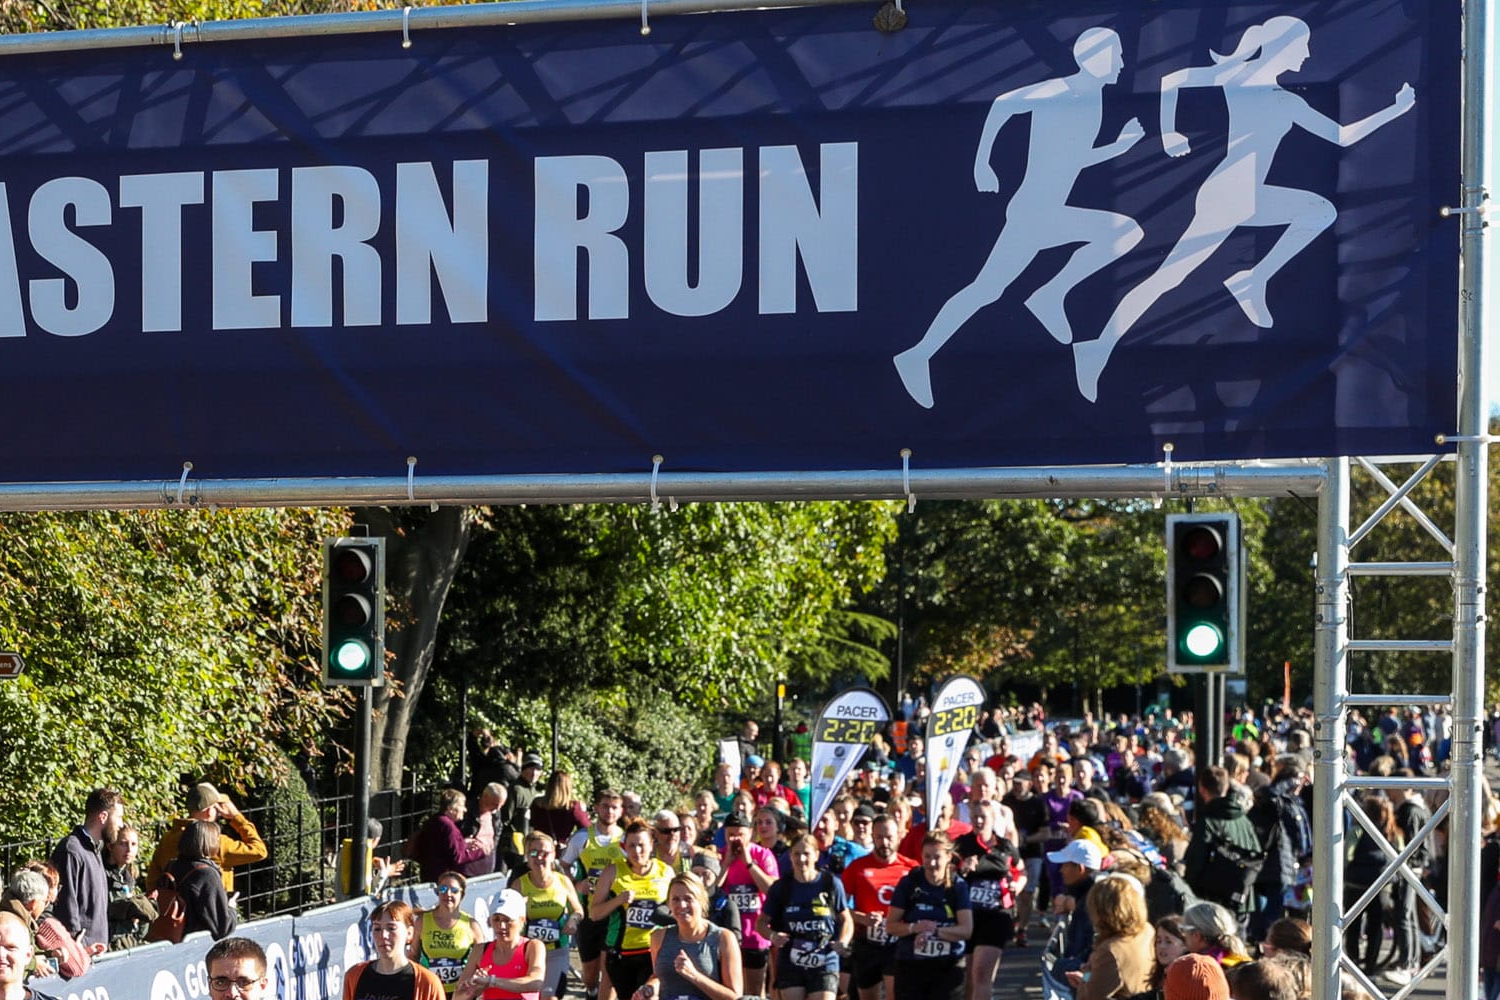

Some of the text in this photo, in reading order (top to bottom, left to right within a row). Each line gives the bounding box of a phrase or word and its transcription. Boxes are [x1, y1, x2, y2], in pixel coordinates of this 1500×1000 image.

[533, 141, 859, 322] RUN
[943, 692, 975, 706] PACER
[836, 705, 878, 718] PACER
[934, 706, 977, 735] 2:20
[823, 719, 876, 742] 2:20
[432, 930, 454, 940] Rae
[533, 927, 555, 941] 596
